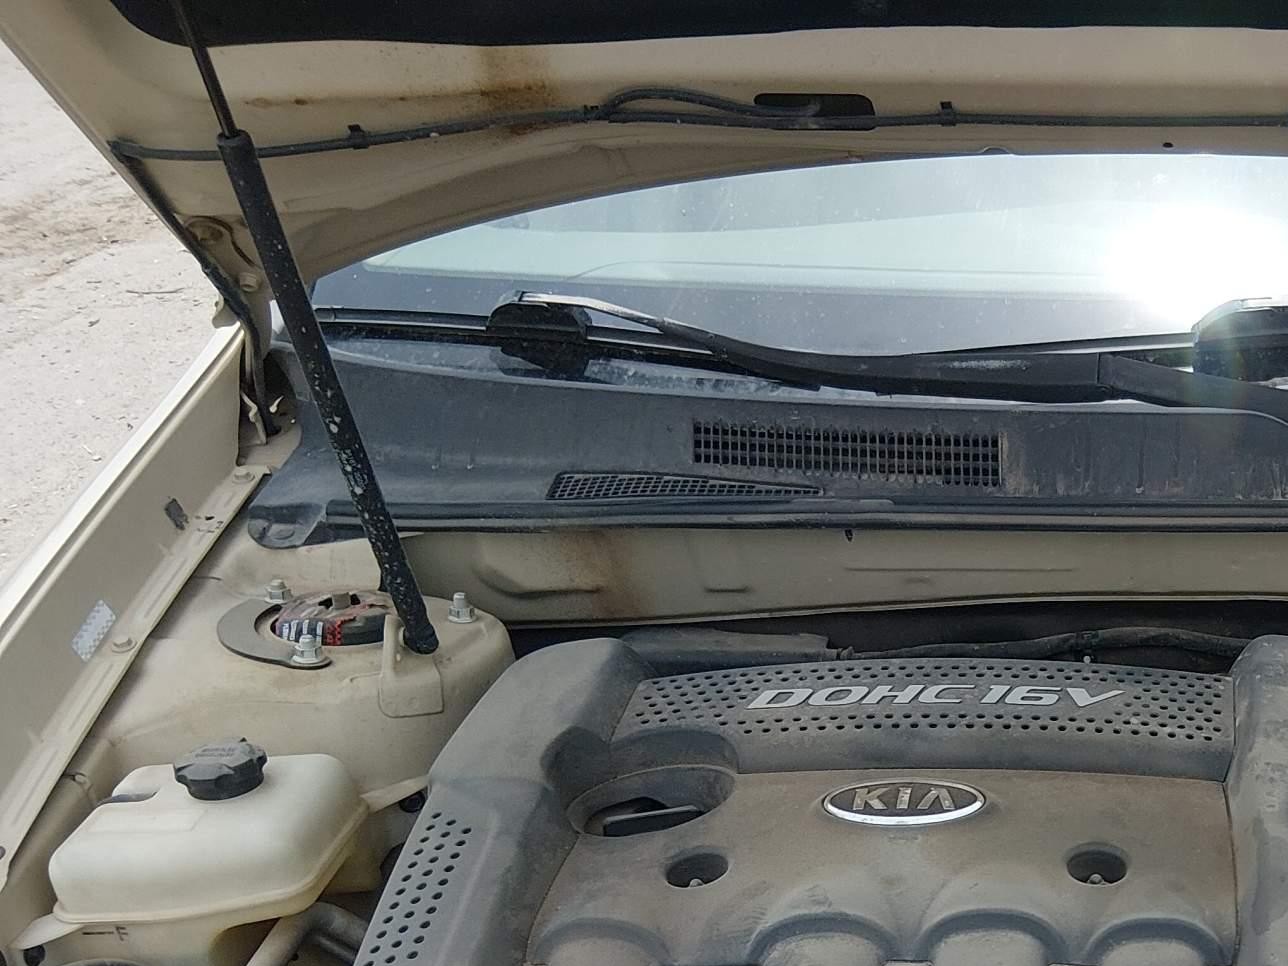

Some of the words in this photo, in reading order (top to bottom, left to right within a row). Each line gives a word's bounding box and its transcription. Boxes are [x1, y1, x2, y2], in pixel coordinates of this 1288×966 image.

[745, 683, 977, 710] DOHC
[979, 684, 1127, 708] 16V
[852, 786, 956, 811] KIA
